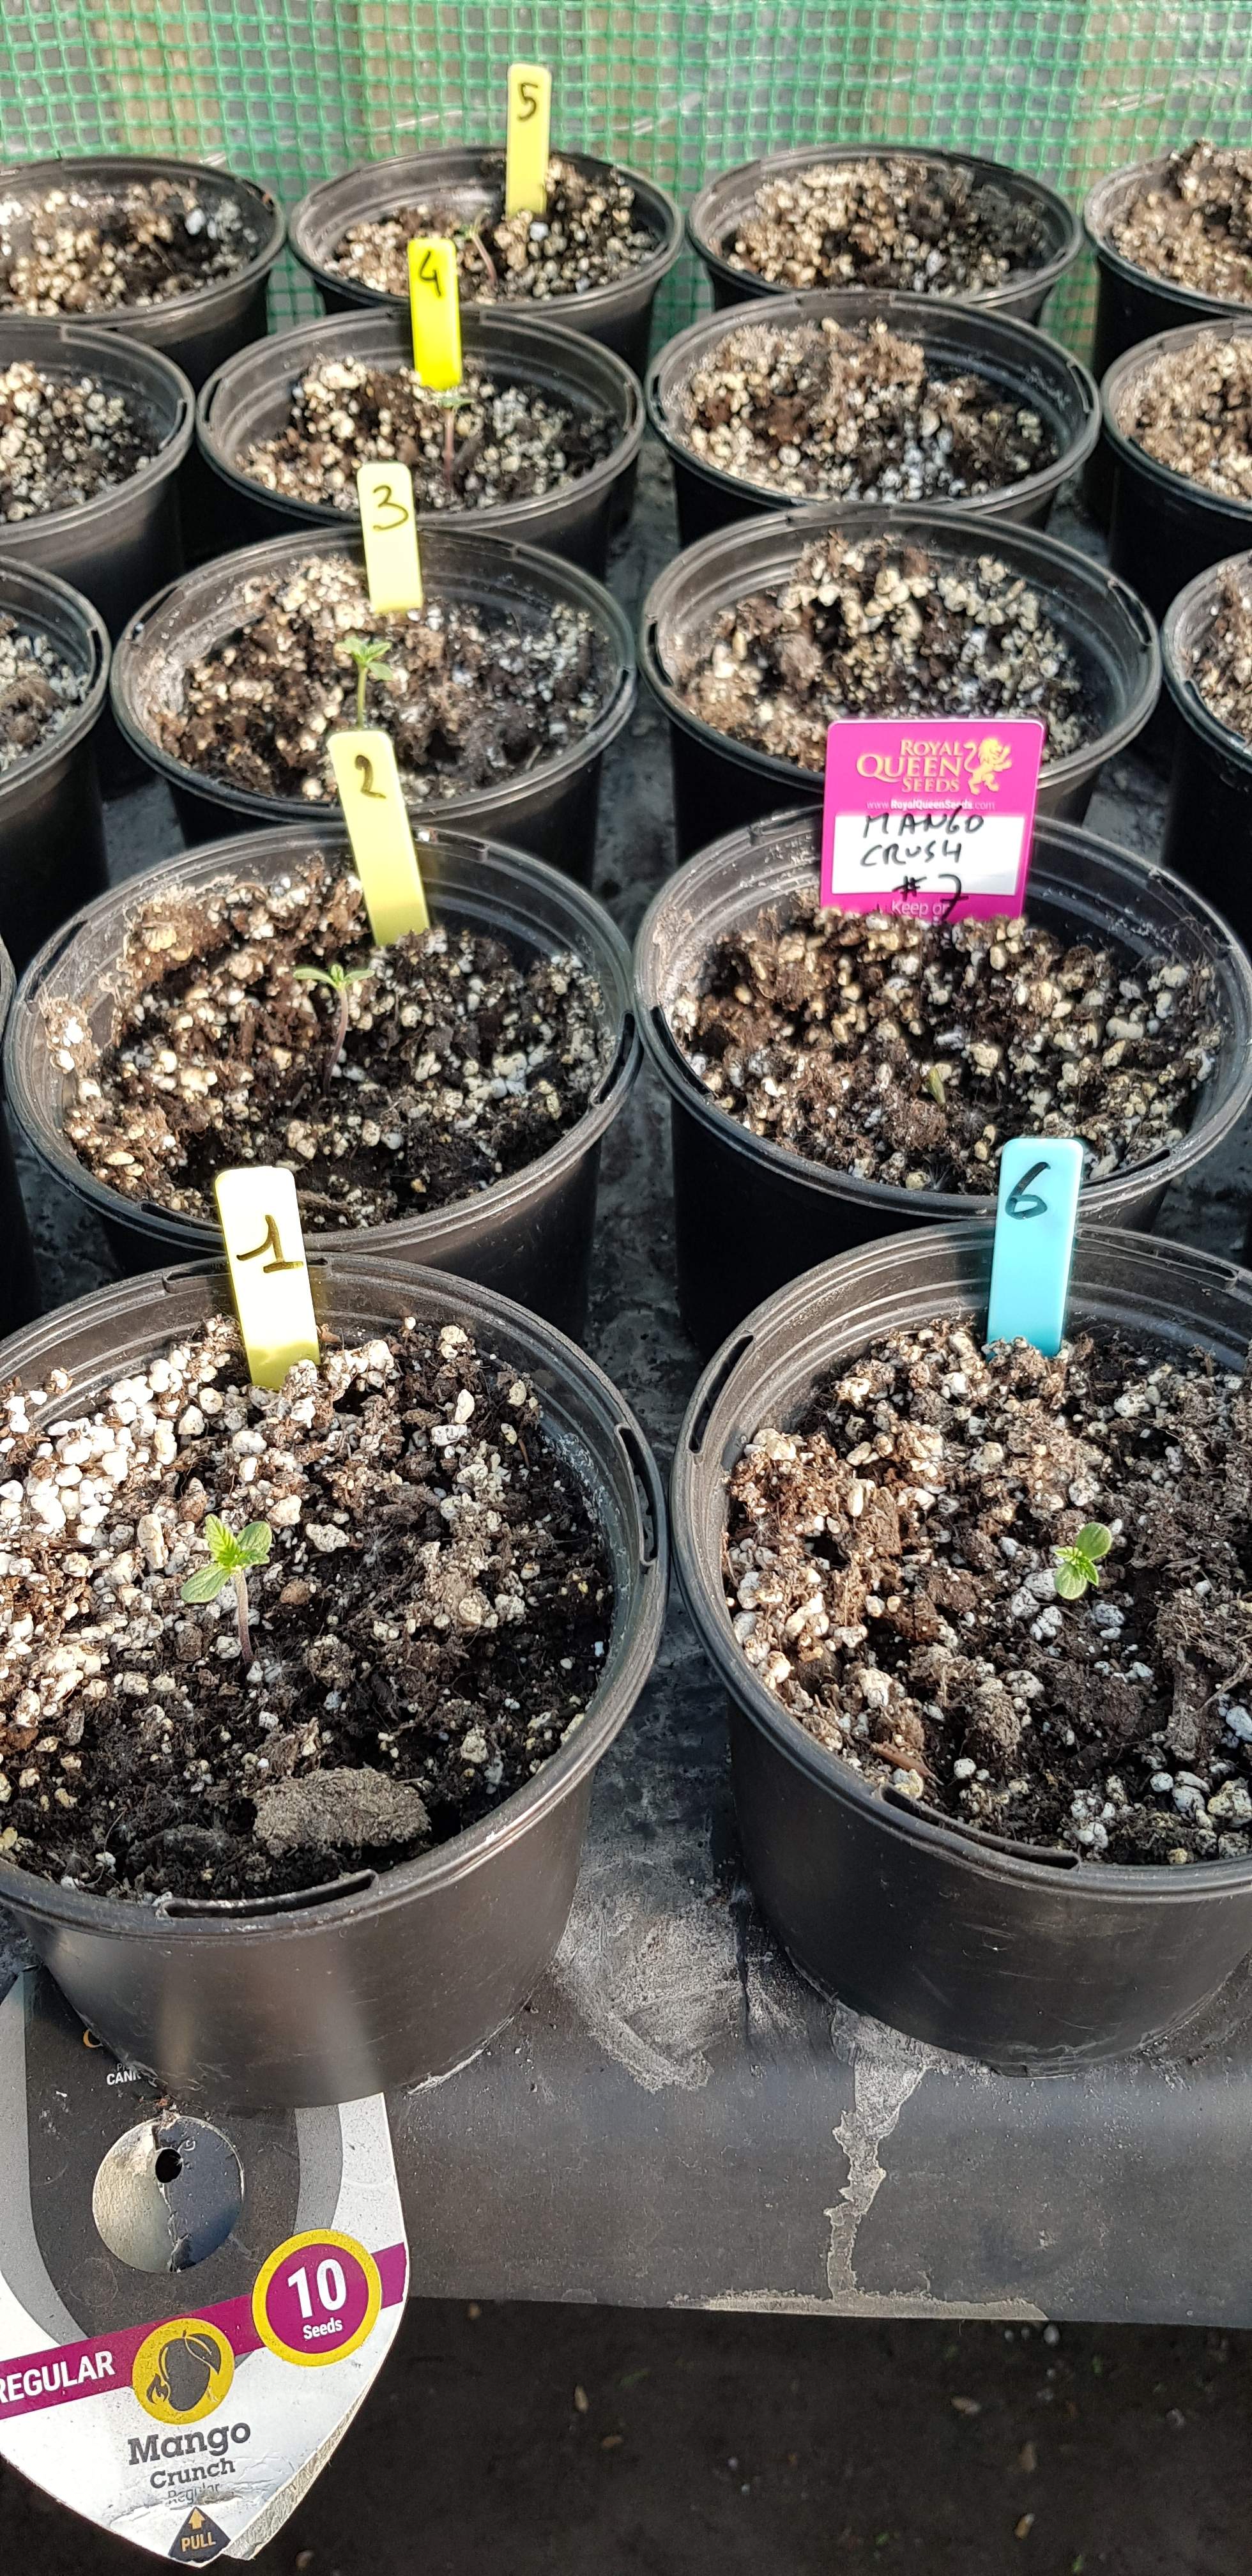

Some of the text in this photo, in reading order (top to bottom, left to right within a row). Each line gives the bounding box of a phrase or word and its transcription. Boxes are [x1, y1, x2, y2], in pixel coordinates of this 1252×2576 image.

[517, 82, 538, 122] 5
[417, 251, 442, 298] 4
[372, 485, 409, 530] 3
[901, 739, 963, 756] ROYAL
[355, 755, 386, 799] 2
[856, 754, 962, 783] QUEEN
[901, 777, 960, 793] SEEDS
[863, 805, 984, 838] MANGO
[860, 839, 961, 867] CRUSH
[892, 900, 928, 917] Keep
[1005, 1162, 1051, 1220] 6
[236, 1215, 303, 1273] 1
[287, 2258, 346, 2319] 10
[303, 2317, 342, 2340] Seeds
[128, 2422, 251, 2465] Mango
[149, 2457, 236, 2489] Crunch
[181, 2532, 217, 2552] PULL
